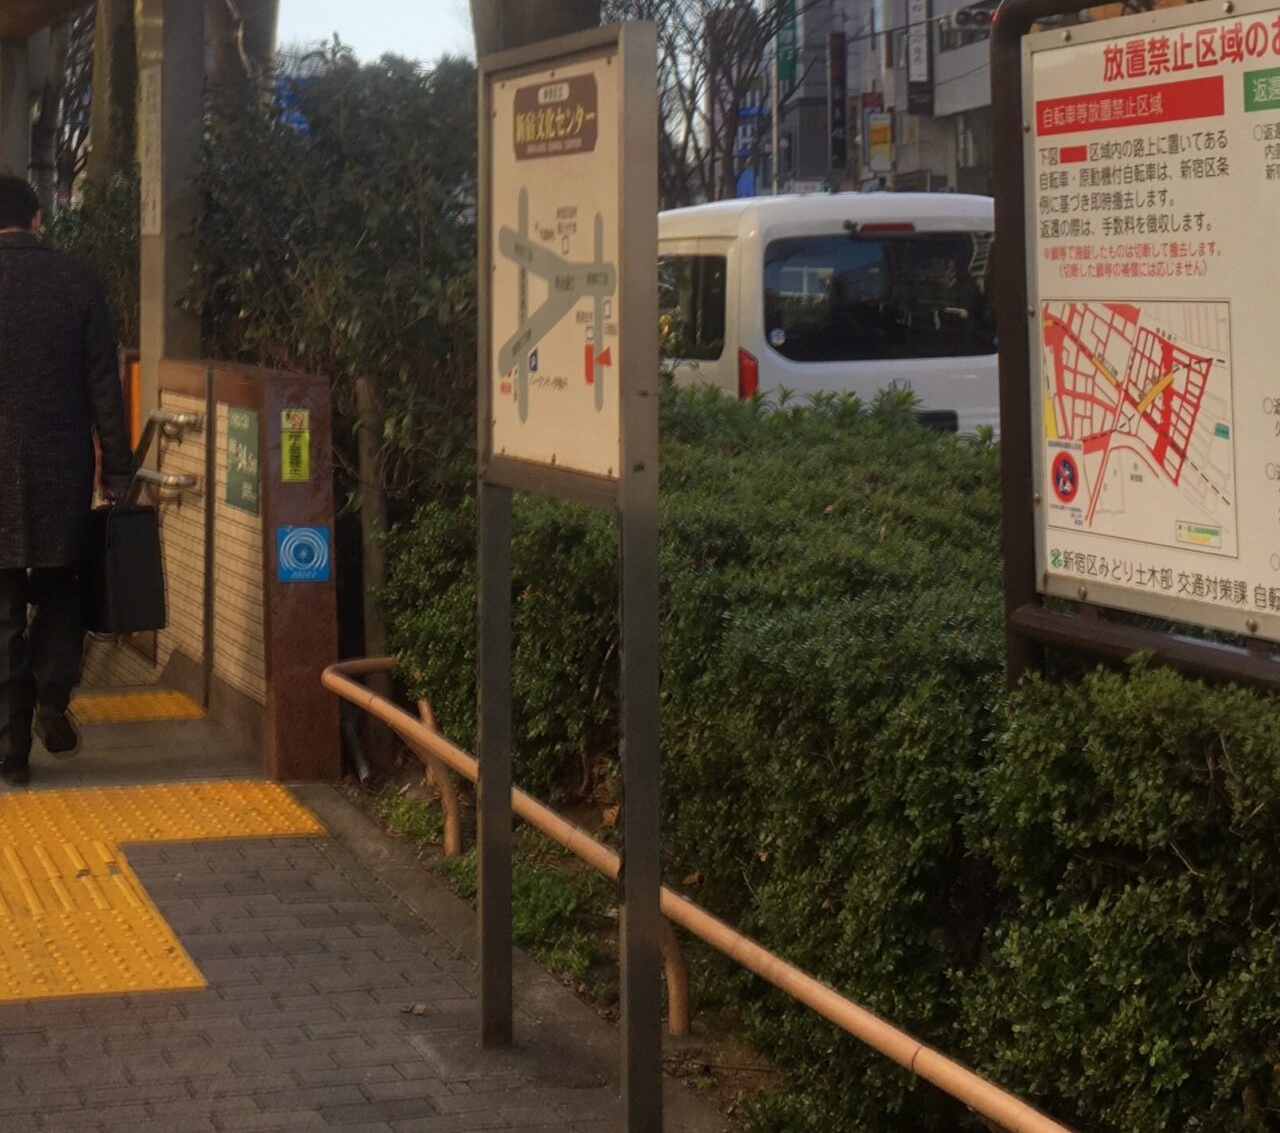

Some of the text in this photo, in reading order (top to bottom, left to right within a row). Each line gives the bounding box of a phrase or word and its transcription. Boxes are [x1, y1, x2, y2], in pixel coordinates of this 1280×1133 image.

[1042, 92, 1163, 129] 自転車等放置禁止区域
[1089, 130, 1228, 162] 区域内の路上に置いてある
[1063, 550, 1174, 590] 新宿区みどり土木部
[1177, 573, 1249, 606] 交通対策課
